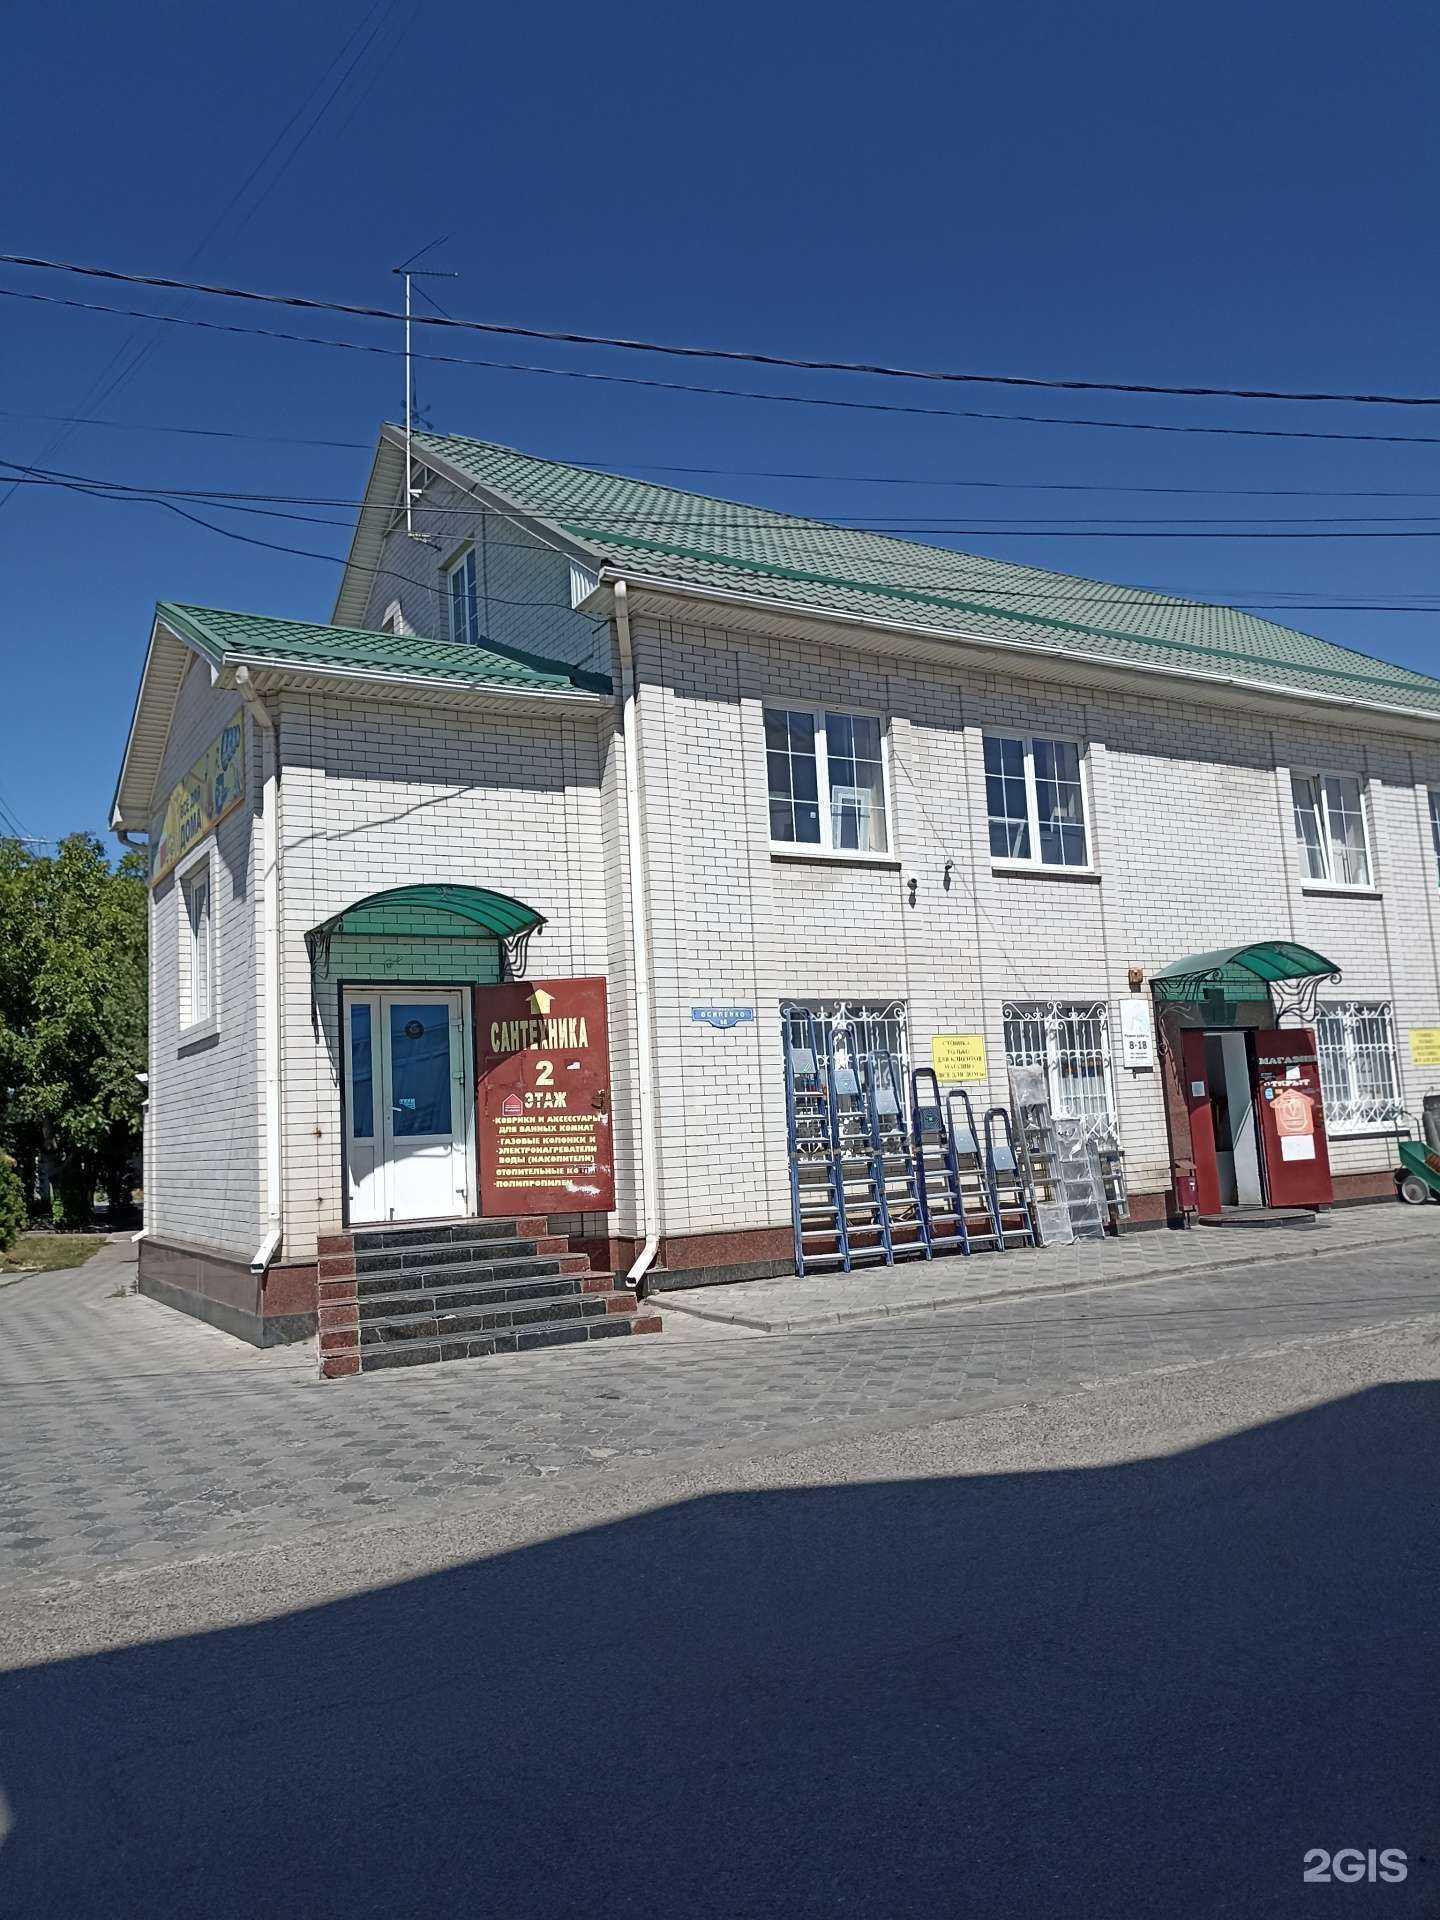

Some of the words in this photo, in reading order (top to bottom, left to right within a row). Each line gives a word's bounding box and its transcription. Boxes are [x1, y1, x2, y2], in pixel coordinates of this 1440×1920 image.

[490, 1017, 589, 1053] САНТЕХНИКА
[1129, 1041, 1148, 1049] 8-18
[535, 1060, 555, 1086] 2
[524, 1091, 567, 1109] ЭТАЖ
[495, 1116, 536, 1125] КОВРИКИ
[547, 1114, 601, 1123] АКСЕССУАРЫ
[499, 1126, 517, 1134] ДЛЯ
[519, 1125, 557, 1133] ВАННЫХ
[559, 1124, 594, 1132] КОМНАТ
[500, 1137, 541, 1145] ГАЗОВЫЕ
[542, 1136, 587, 1144] КОЛОНКИ
[498, 1145, 597, 1155] ЭЛЕКТРОНАГРЕВАТЕЛИ
[498, 1156, 526, 1165] ВОДЫ
[527, 1154, 595, 1165] (НАКОПИТЕЛИ)
[495, 1167, 565, 1176] ОТОПИТЕЛЬНЫЕ
[495, 1179, 573, 1188] ПОЛИПРОПИЛЕН
